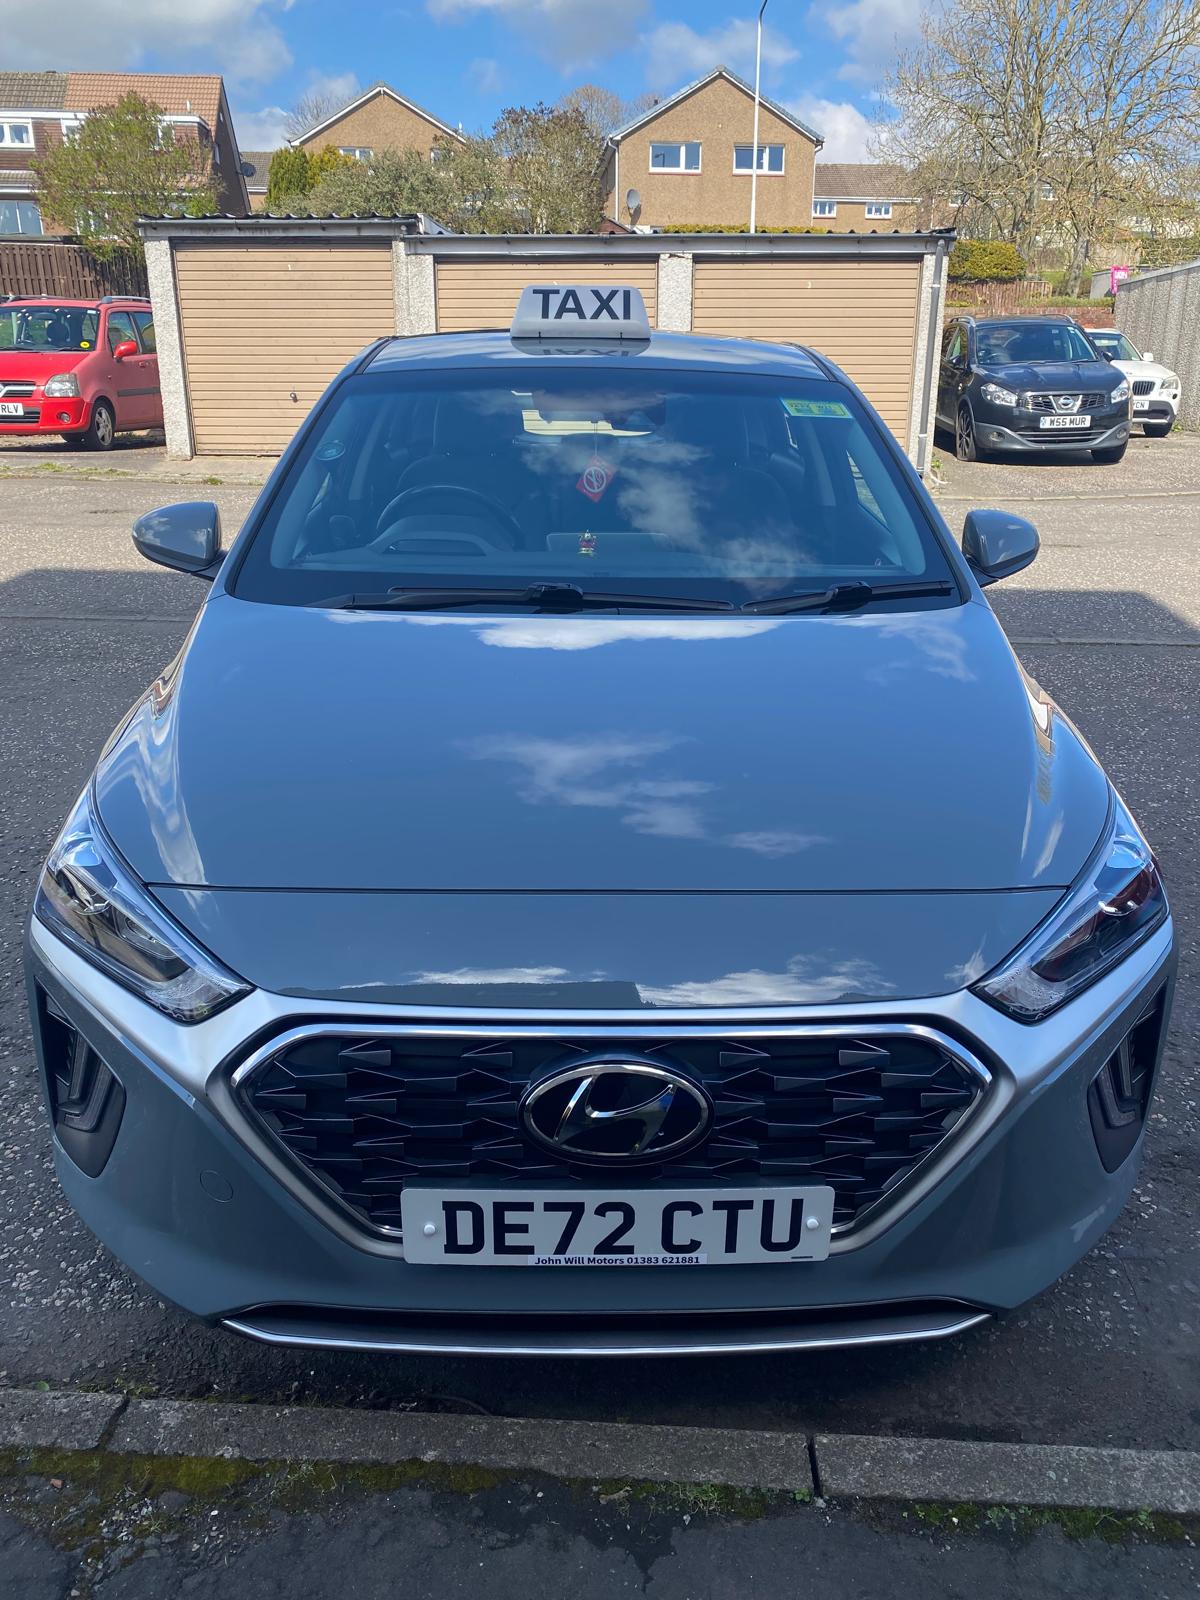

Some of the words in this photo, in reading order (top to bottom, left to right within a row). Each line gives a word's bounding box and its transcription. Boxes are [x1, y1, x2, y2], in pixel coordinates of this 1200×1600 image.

[532, 289, 631, 320] TAXI
[0, 404, 19, 414] RLV
[1069, 416, 1087, 426] MUR
[442, 1200, 636, 1256] DE72
[660, 1198, 804, 1254] CTU
[535, 1256, 563, 1265] John
[564, 1256, 585, 1265] Will
[587, 1256, 624, 1265] Motors
[626, 1256, 659, 1265] 01383
[661, 1256, 700, 1265] 621881
